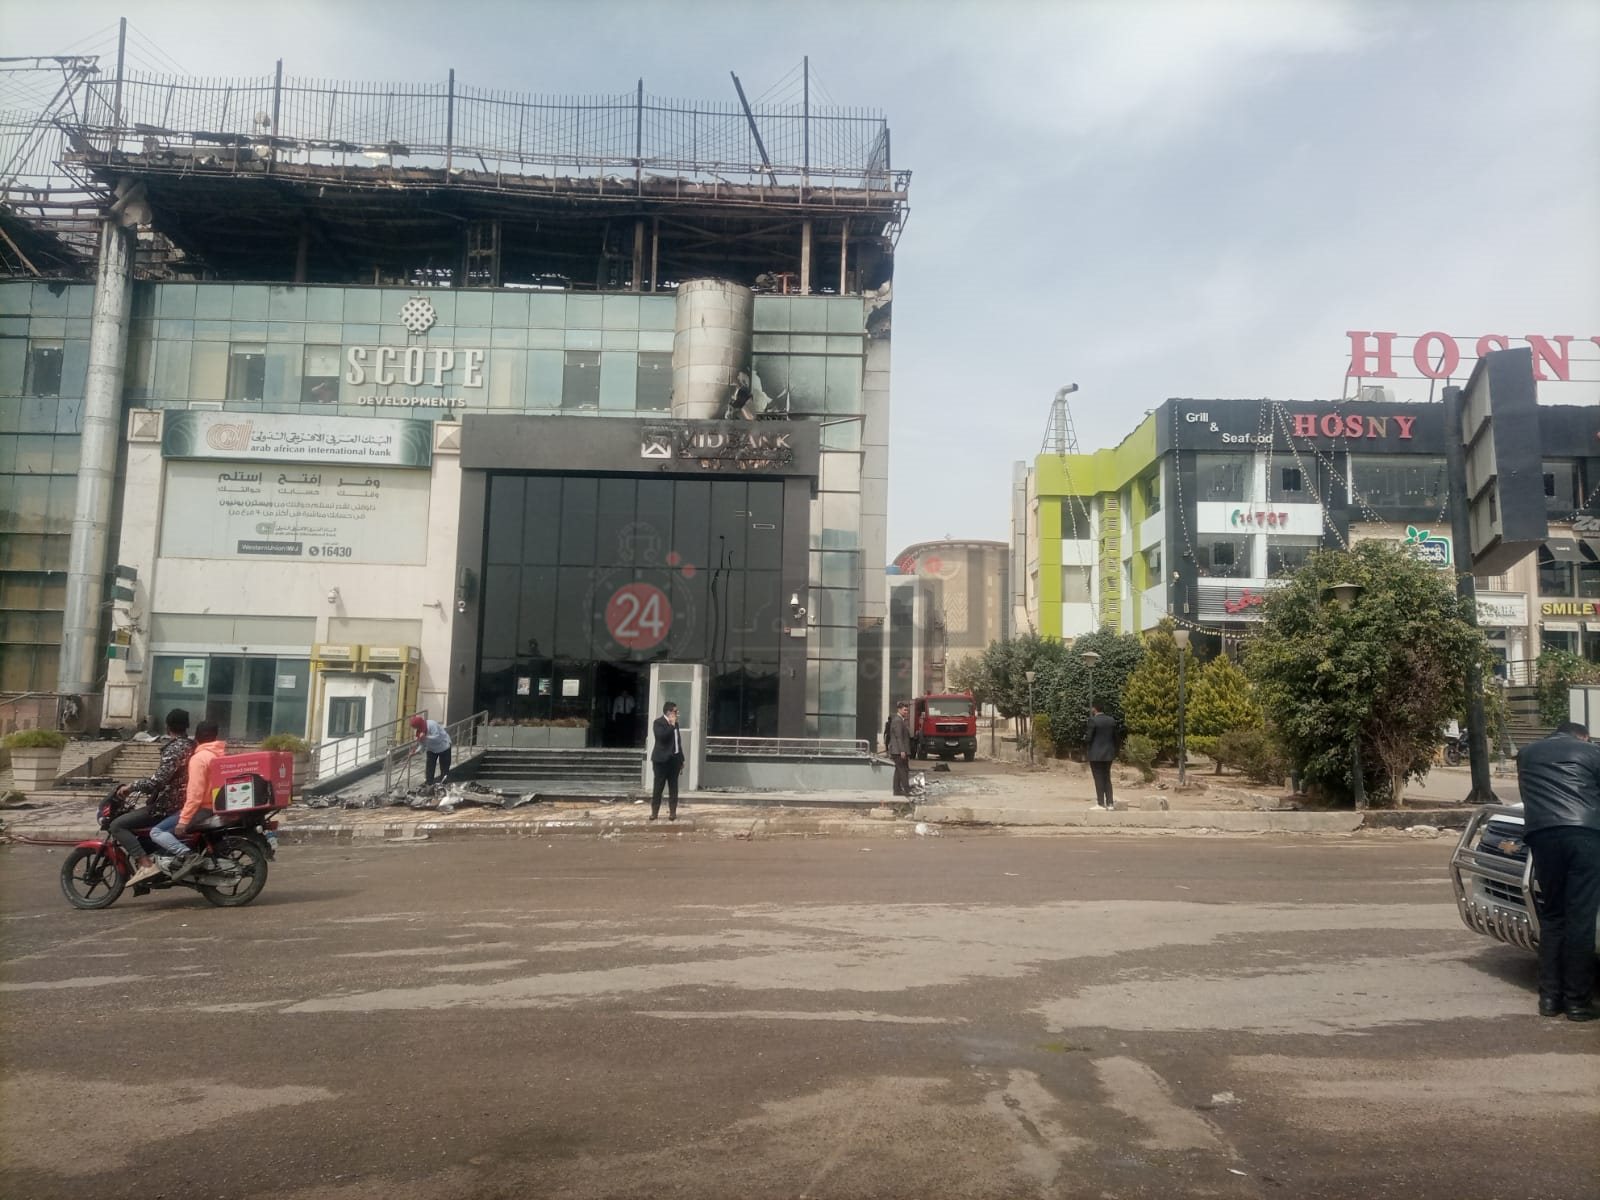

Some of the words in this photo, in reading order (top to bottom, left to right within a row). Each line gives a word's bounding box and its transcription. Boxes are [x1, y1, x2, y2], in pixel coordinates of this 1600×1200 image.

[1346, 331, 1600, 382] HON
[346, 346, 485, 388] SCOPE
[357, 396, 467, 408] DEVELOPMENTS
[1186, 412, 1209, 423] Grill
[1210, 421, 1219, 432] &
[1293, 413, 1417, 439] HOSNY
[361, 435, 391, 446] البنك
[1221, 432, 1273, 444] Seafood
[250, 444, 271, 453] arab
[273, 444, 305, 454] african
[308, 445, 366, 456] international
[368, 448, 391, 457] bank
[322, 546, 352, 557] 16430
